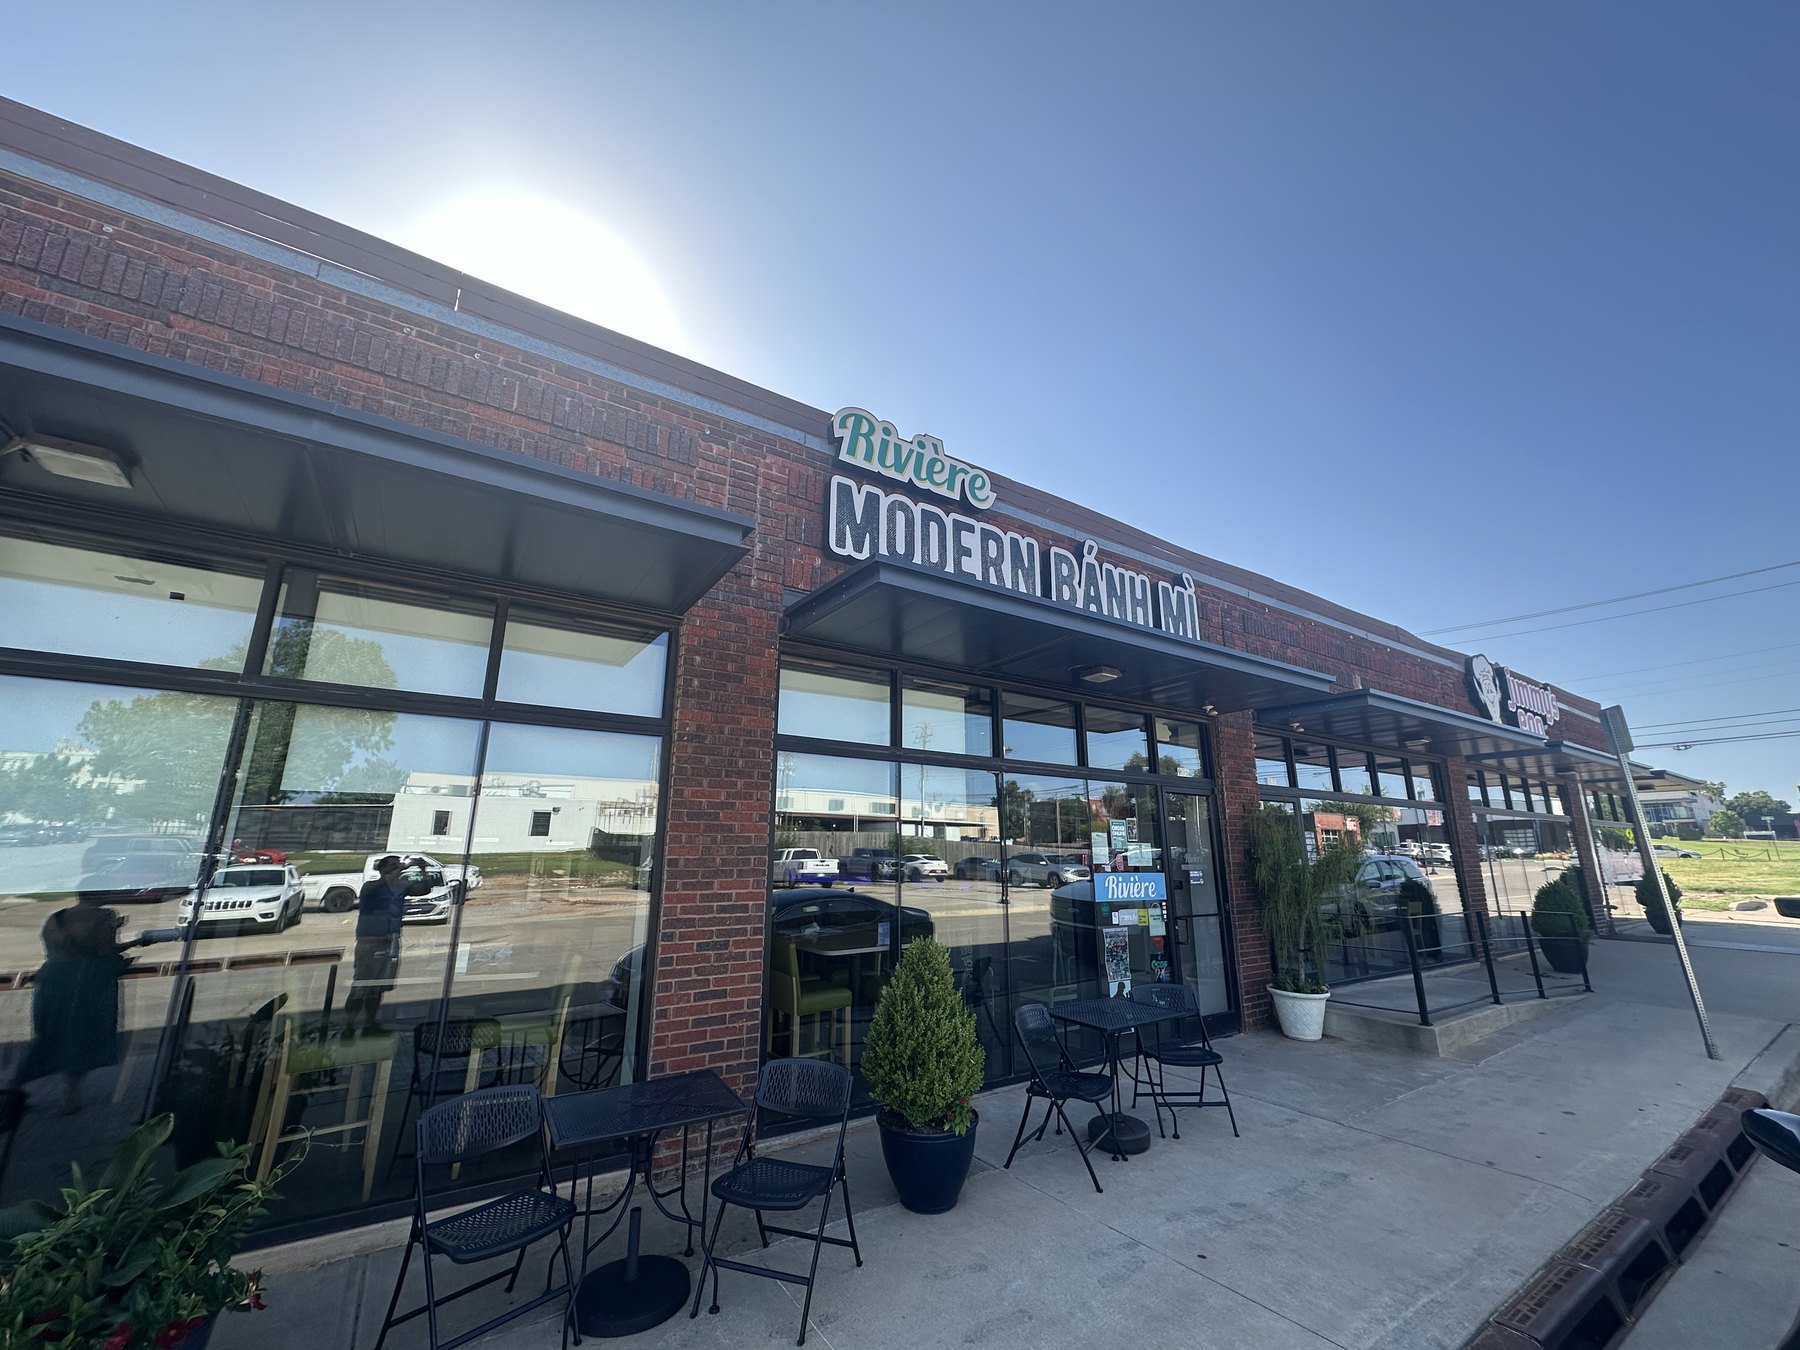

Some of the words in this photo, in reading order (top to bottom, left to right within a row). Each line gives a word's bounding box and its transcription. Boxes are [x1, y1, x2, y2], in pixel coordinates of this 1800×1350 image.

[836, 410, 993, 504] Rivière
[831, 477, 1040, 597] MODERN
[1050, 540, 1152, 628] BÁNH
[1104, 875, 1157, 899] Rivière
